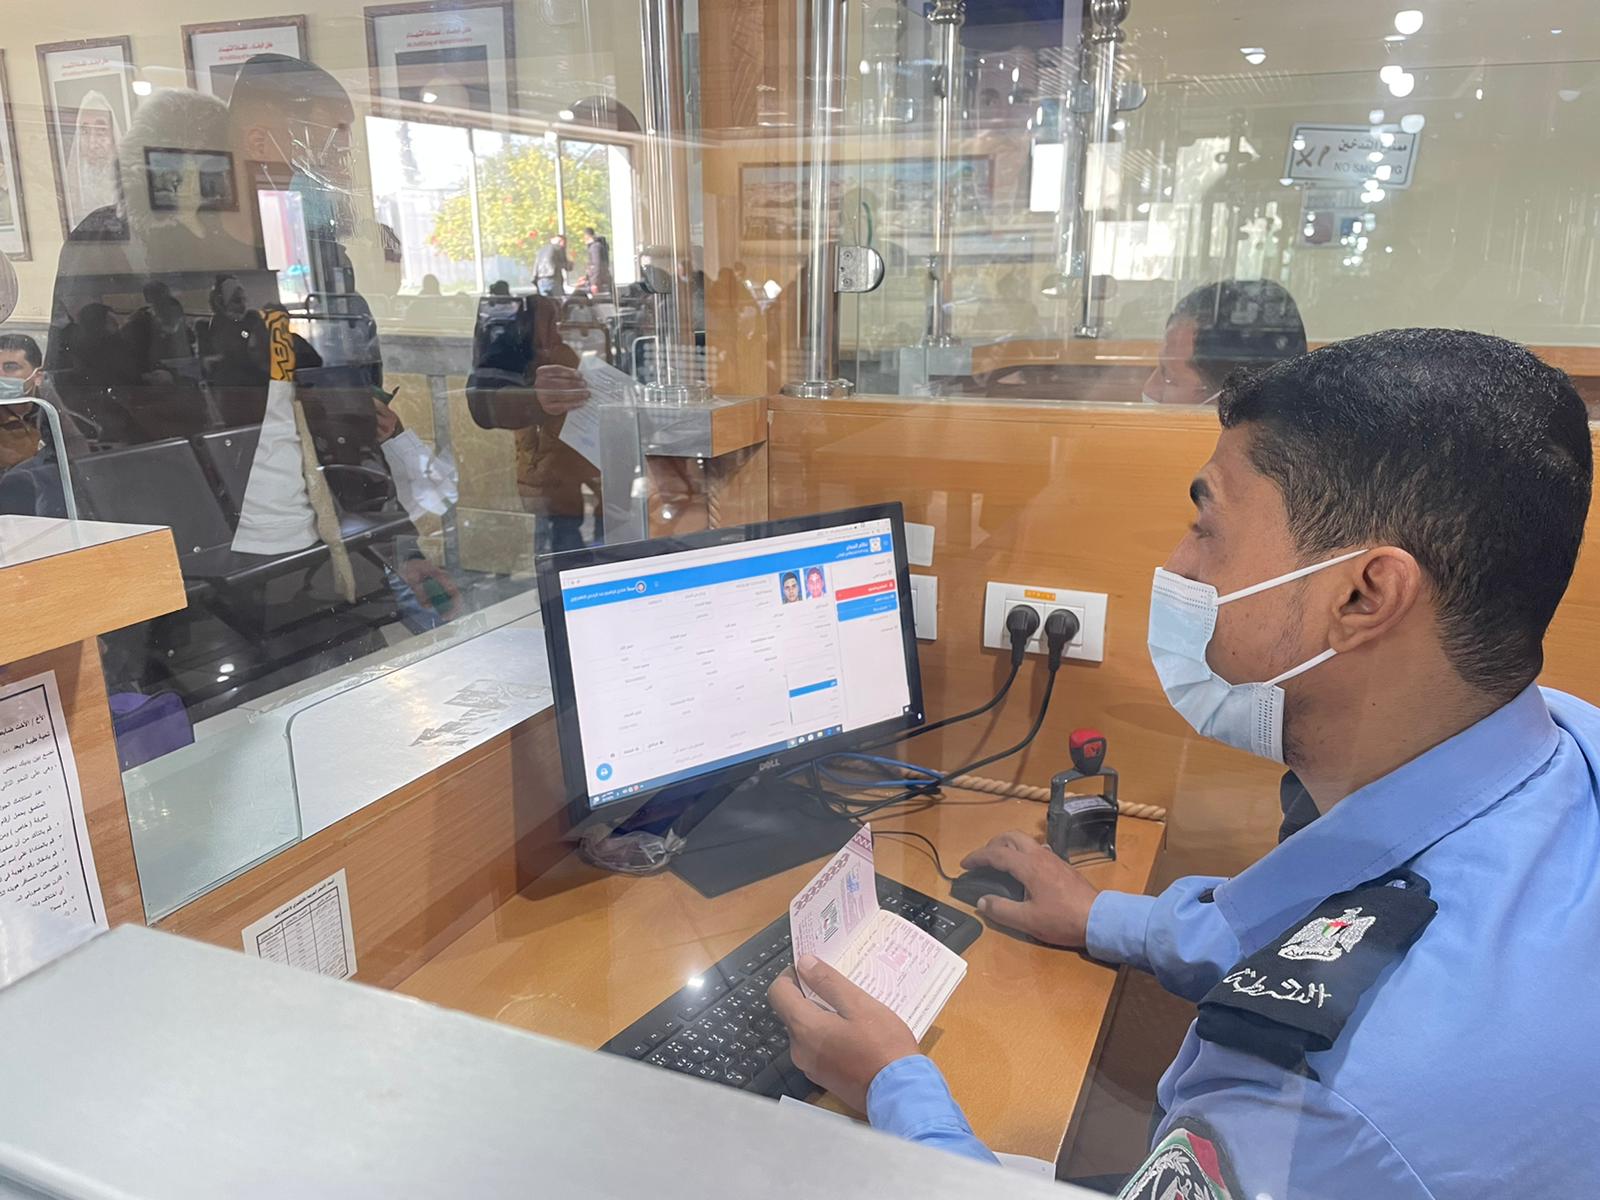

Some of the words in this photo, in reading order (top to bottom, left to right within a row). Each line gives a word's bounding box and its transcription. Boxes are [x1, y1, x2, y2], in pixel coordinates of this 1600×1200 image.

[1334, 161, 1351, 173] NO
[1352, 162, 1402, 175] SMOG
[759, 758, 781, 771] DELL
[1222, 967, 1333, 1009] الشرطة
